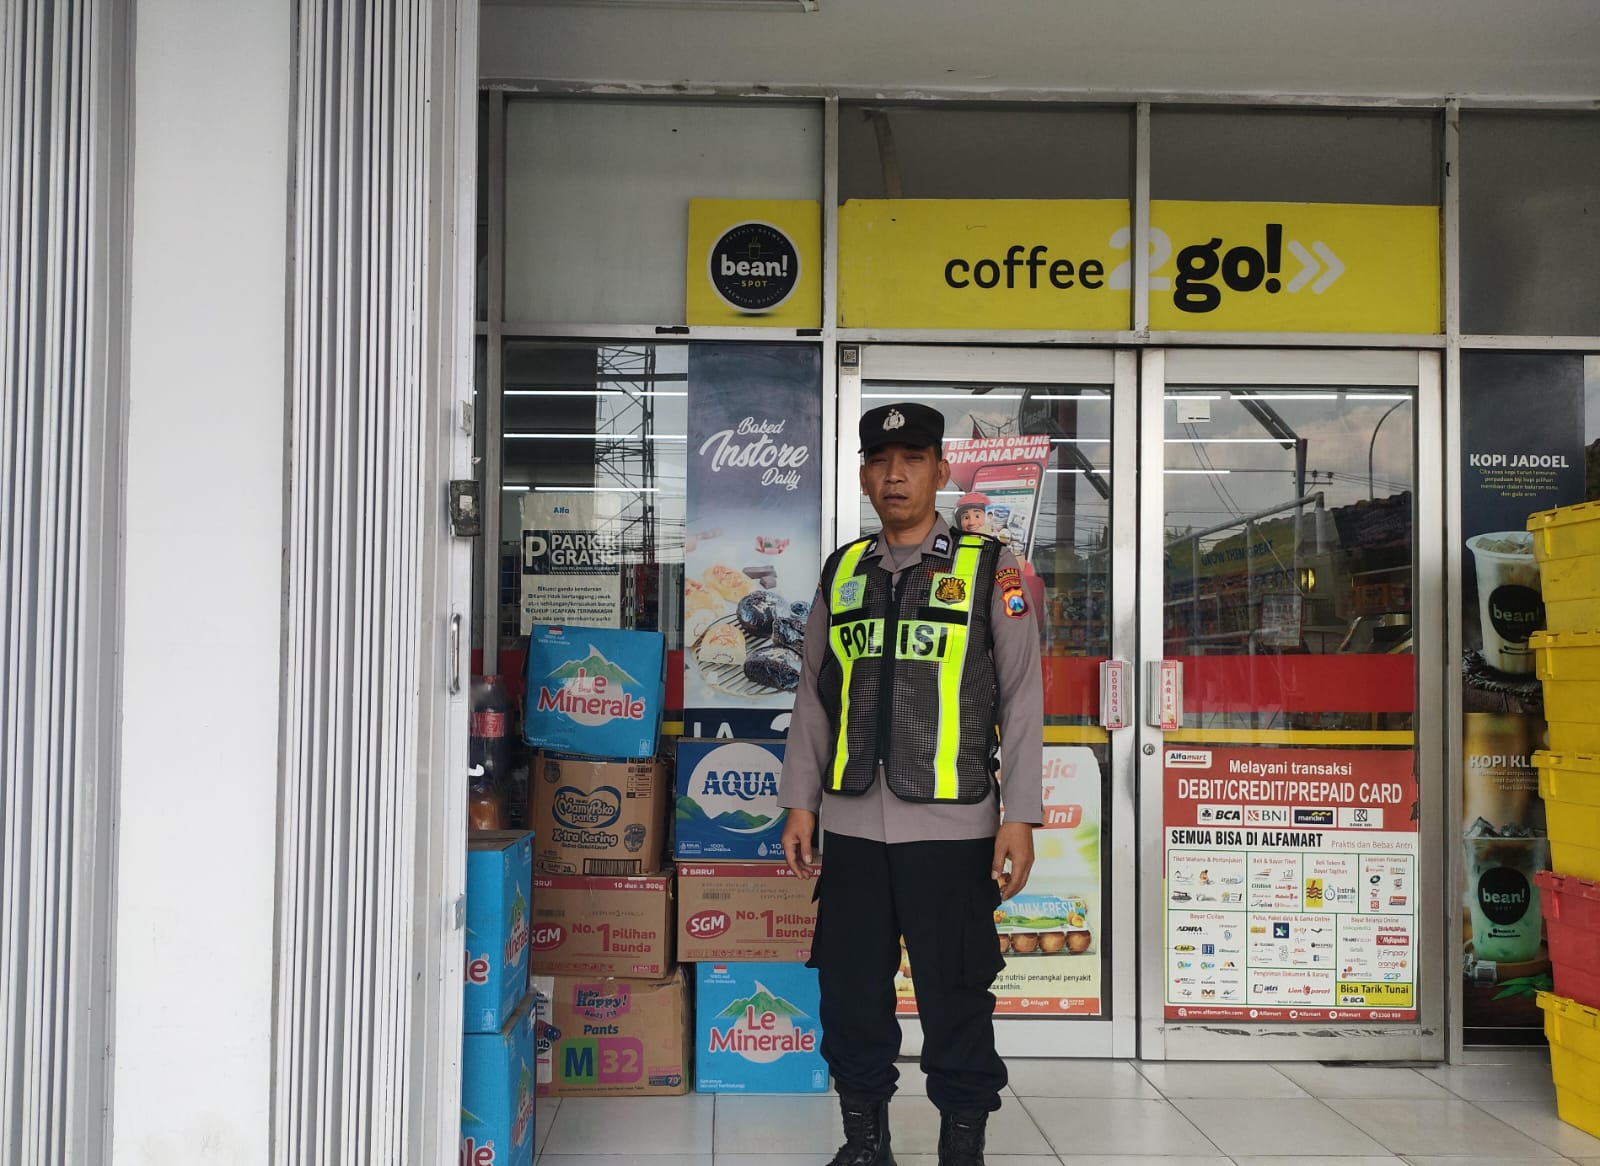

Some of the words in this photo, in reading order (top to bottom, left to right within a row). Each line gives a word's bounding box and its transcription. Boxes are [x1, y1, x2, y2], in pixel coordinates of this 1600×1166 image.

[721, 254, 788, 277] bean!
[945, 245, 1104, 289] coffee
[737, 416, 784, 435] Baked
[699, 429, 810, 472] Instore
[948, 437, 1006, 451] BELANJA
[1006, 435, 1051, 447] ONLINE
[946, 446, 1049, 464] DIMANAPUN
[1470, 454, 1507, 467] KOPI
[1510, 454, 1569, 468] JADOEL
[761, 467, 801, 491] Daily
[551, 534, 617, 550] PARKIR
[525, 536, 547, 567] P
[551, 550, 616, 566] GRATIS
[577, 667, 608, 695] Le
[537, 686, 645, 720] Minerale
[1170, 752, 1207, 761] Alfamart
[1470, 755, 1507, 768] KOPI
[1510, 755, 1533, 768] KL
[1229, 760, 1288, 777] Melayani
[1291, 762, 1352, 776] transaksi
[701, 770, 779, 801] AQUA
[1178, 778, 1355, 803] DEBIT/CREDIT/PREPAID
[1359, 783, 1403, 804] CARD
[556, 793, 615, 815] MamyPoko
[572, 813, 598, 823] pants
[1048, 807, 1074, 824] Ini
[1215, 810, 1241, 821] BCA
[1262, 810, 1287, 822] BNI
[1298, 813, 1325, 822] mandiri
[580, 831, 618, 848] Kering
[1171, 830, 1212, 846] SEMUA
[1215, 831, 1242, 846] BISA
[1246, 832, 1258, 846] DI
[1261, 832, 1323, 847] ALFAMART
[1331, 840, 1355, 849] Praktis
[1356, 841, 1371, 849] dan
[1372, 841, 1394, 850] Bebas
[1395, 842, 1413, 850] Antri
[1482, 887, 1525, 904] bean!
[1042, 901, 1075, 914] FRESH
[690, 914, 725, 933] SGM
[736, 910, 759, 920] No.
[760, 910, 774, 938] 1
[572, 923, 595, 934] No.
[597, 923, 610, 952] 1
[612, 928, 657, 940] Pilihan
[776, 928, 814, 938] Bunda
[612, 943, 651, 953] Bunda
[1383, 949, 1407, 957] Finpay
[1378, 961, 1399, 969] orange
[1027, 974, 1062, 983] penangkal
[1063, 974, 1091, 983] penyakit
[1340, 985, 1359, 993] Bisa
[1361, 985, 1382, 993] Tarik
[1385, 985, 1409, 994] Tunai
[747, 1005, 776, 1031] Le
[583, 1023, 619, 1035] Pants
[709, 1027, 816, 1053] Minerale
[565, 1047, 593, 1078] M
[602, 1049, 638, 1074] 32
